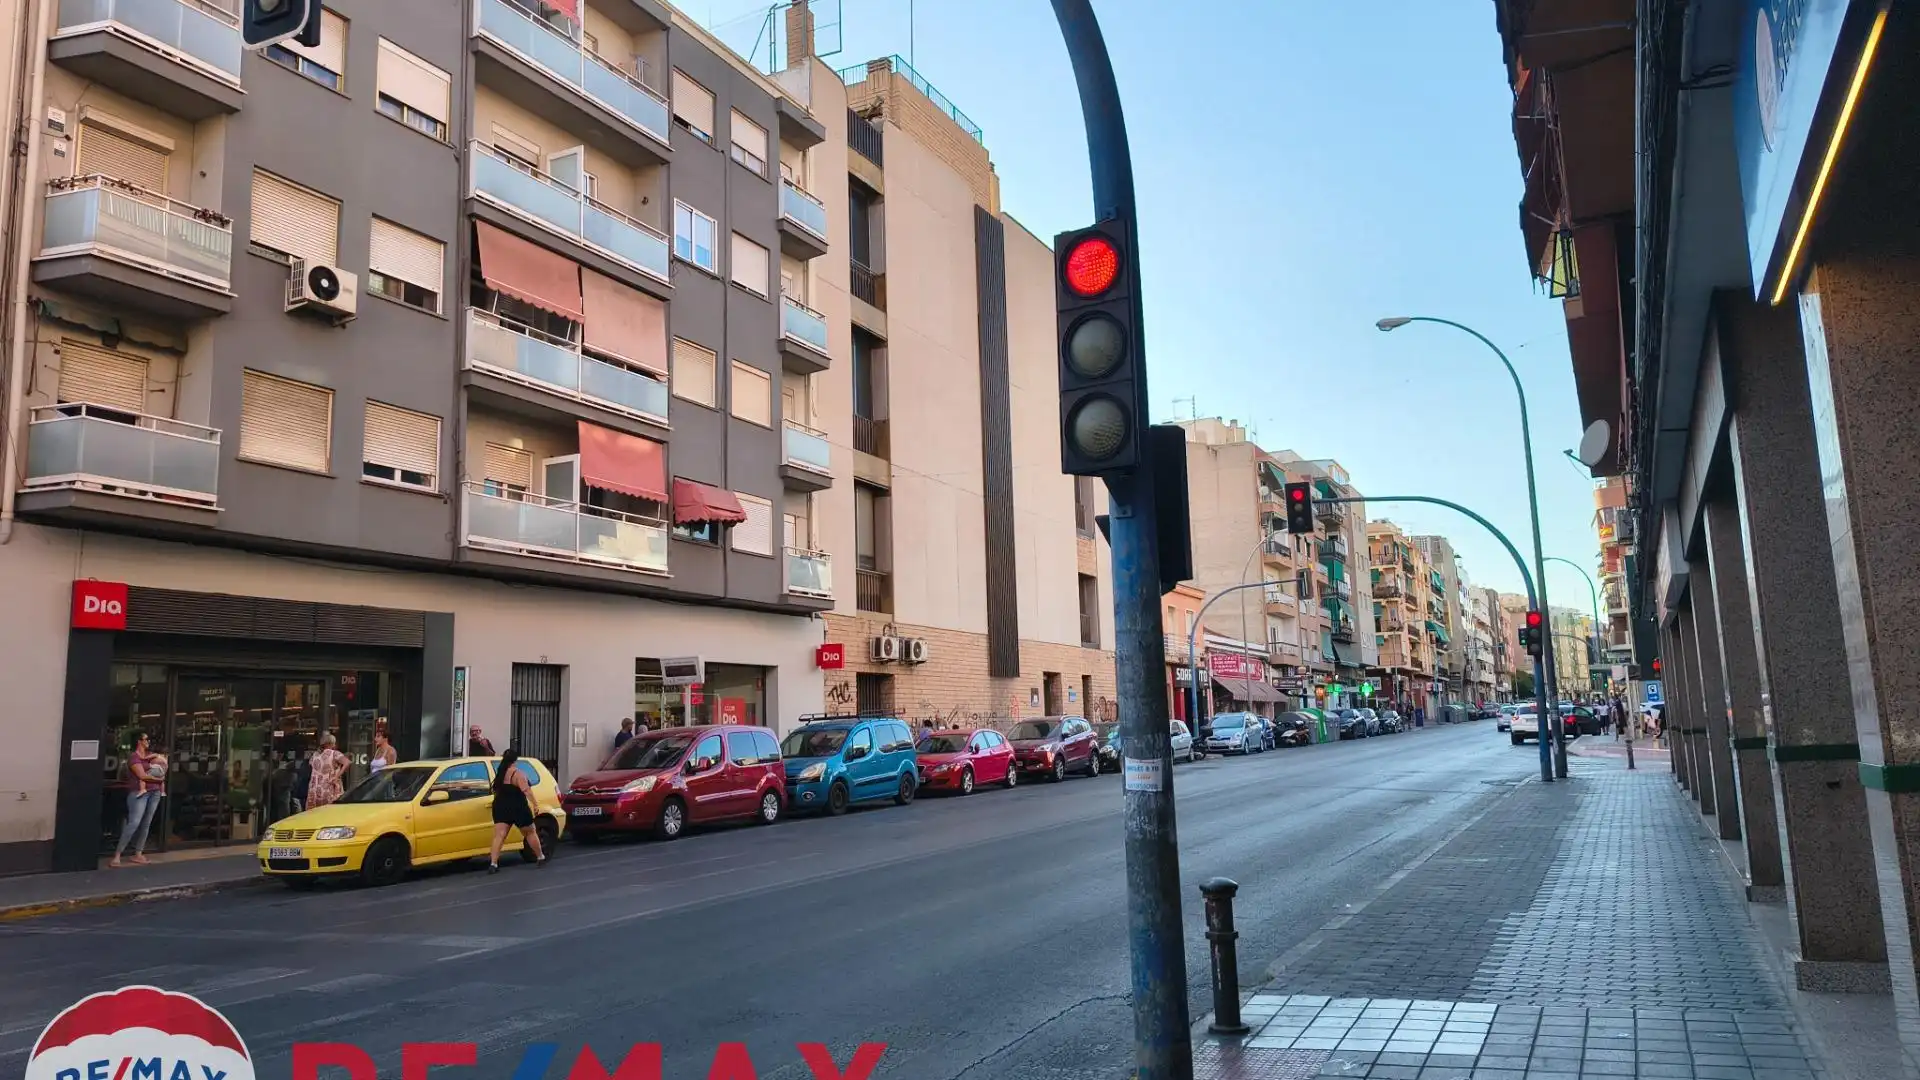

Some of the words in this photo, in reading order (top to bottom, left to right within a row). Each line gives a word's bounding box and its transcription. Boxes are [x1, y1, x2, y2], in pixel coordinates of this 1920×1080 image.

[84, 595, 121, 614] Dia
[822, 652, 839, 661] Dia
[1176, 667, 1208, 682] SORRTO
